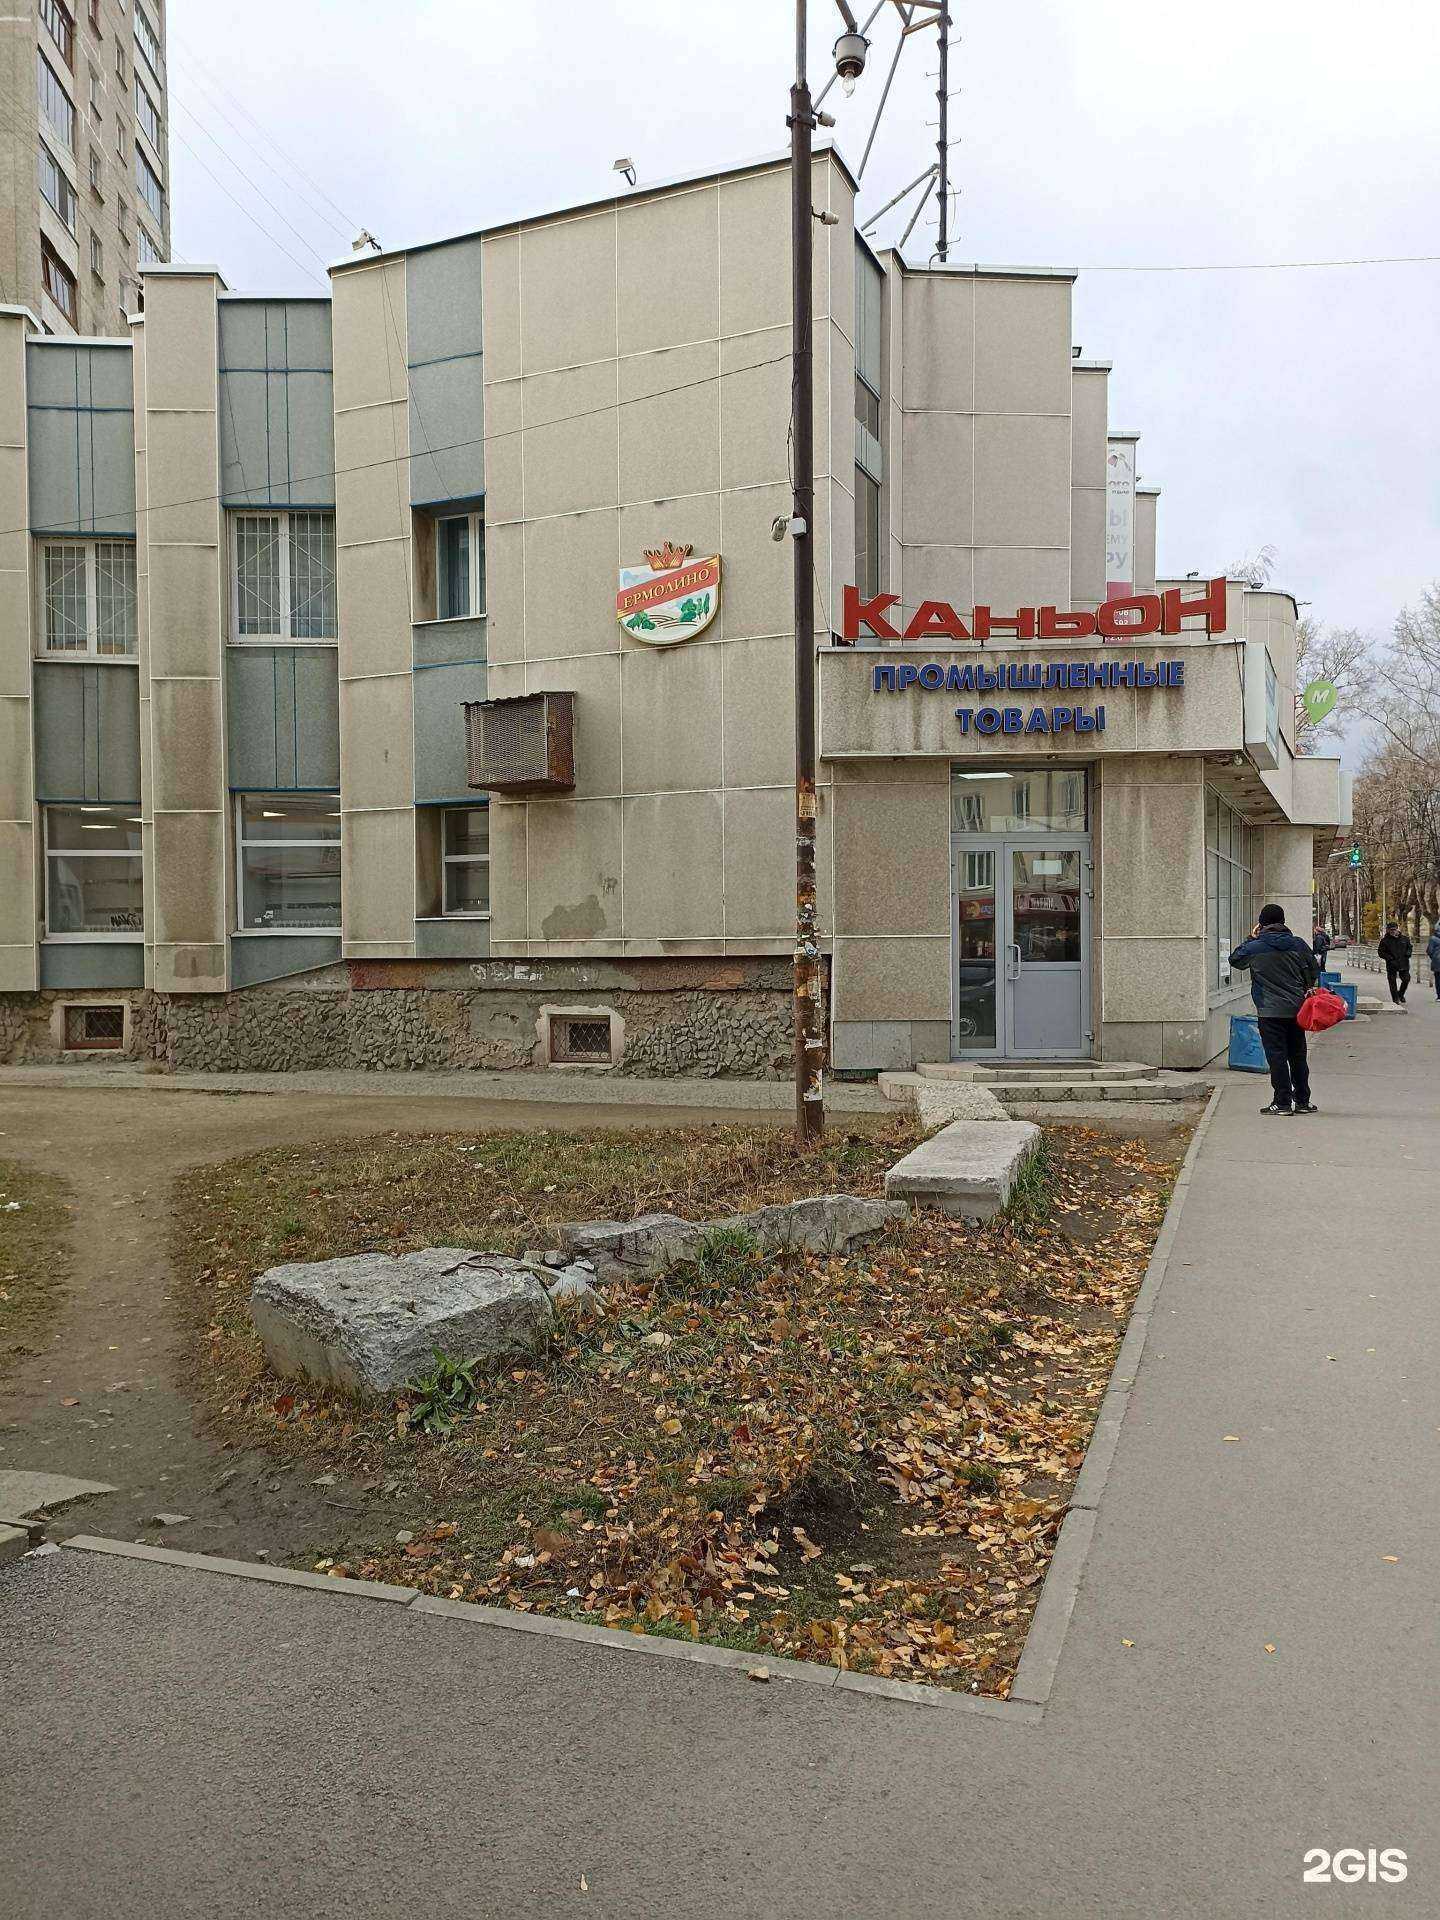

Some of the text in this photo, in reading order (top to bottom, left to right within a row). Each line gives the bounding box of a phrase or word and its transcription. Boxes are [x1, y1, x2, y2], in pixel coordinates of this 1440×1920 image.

[623, 568, 710, 608] ЕРМОЛИНО
[842, 576, 1227, 640] КАНЬОН
[872, 660, 1186, 692] ПРОМЫШЛЕННЫЕ
[954, 705, 1107, 735] ТОВАРЫ
